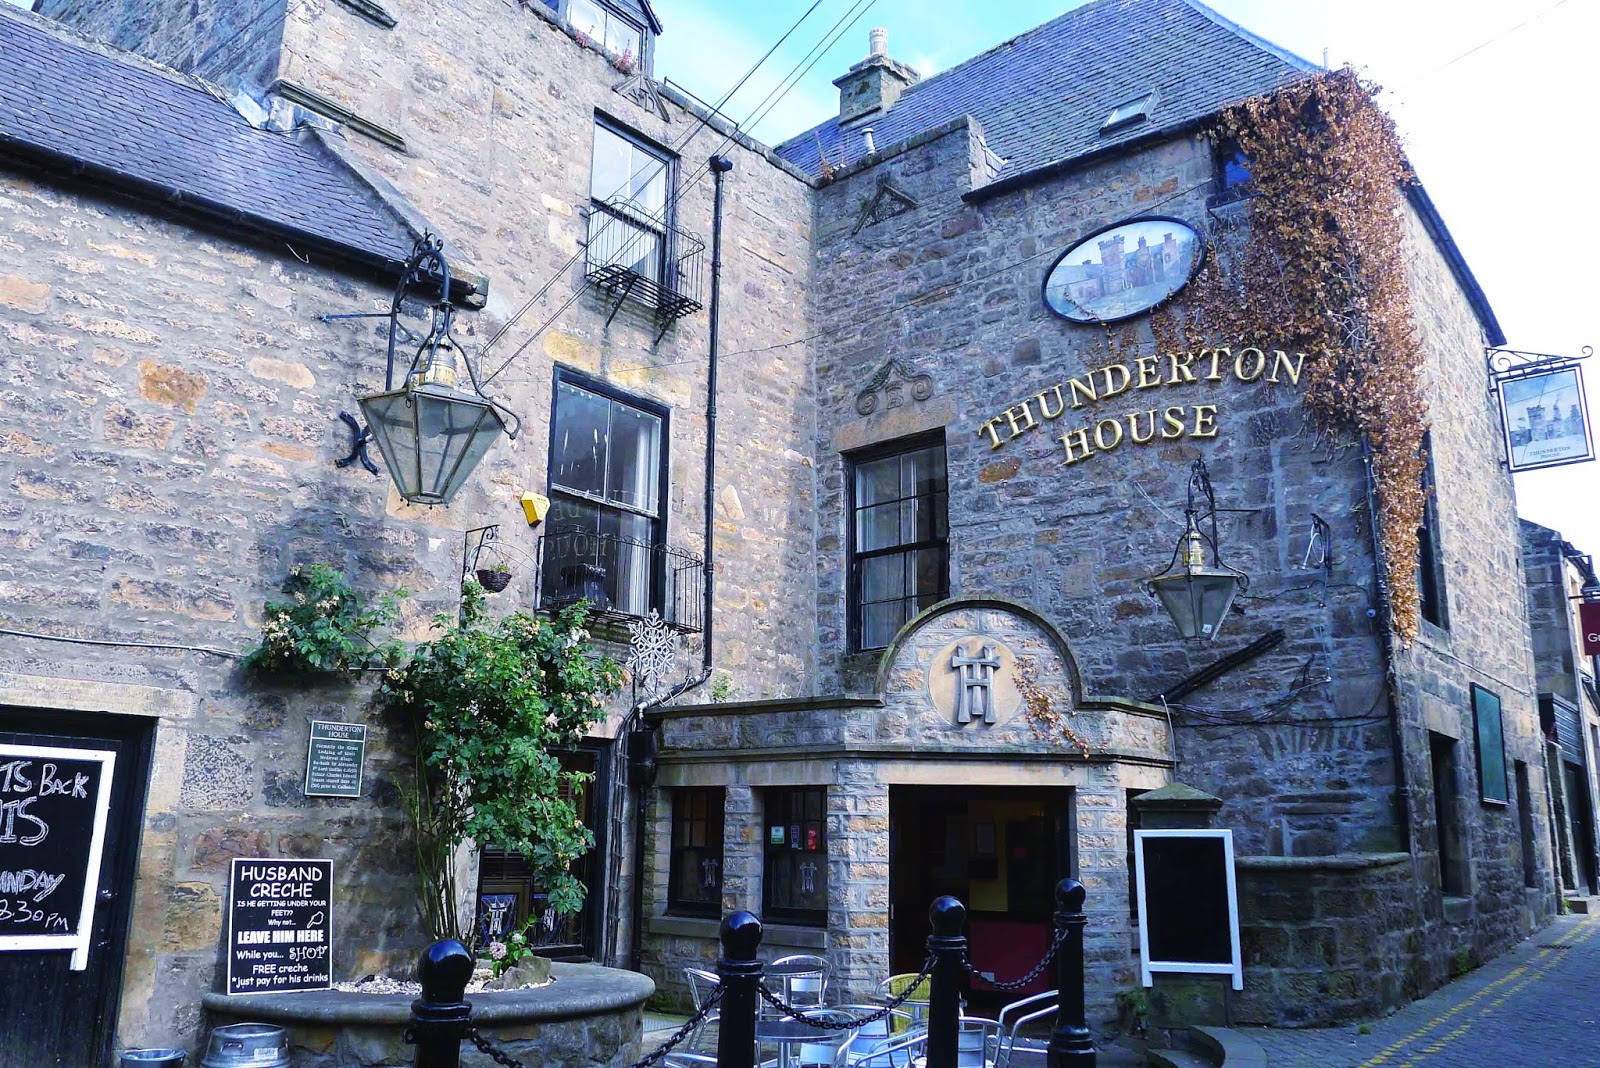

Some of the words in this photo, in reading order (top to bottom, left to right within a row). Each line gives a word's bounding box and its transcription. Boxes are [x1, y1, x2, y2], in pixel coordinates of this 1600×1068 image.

[977, 347, 1306, 451] THUNDERTON
[1059, 403, 1219, 466] HOUSE
[317, 723, 362, 733] THUNDERTON
[328, 731, 350, 739] HOUSE
[0, 795, 49, 847] IS
[241, 865, 323, 881] HUSBAND
[250, 882, 313, 898] CRECHE
[271, 909, 293, 917] FEET??
[267, 919, 281, 927] Why
[237, 930, 271, 945] LEAVE
[272, 930, 295, 943] HIM
[296, 929, 324, 943] HERE
[236, 950, 261, 960] While
[289, 945, 327, 962] SHOP
[252, 964, 277, 975] FREE
[278, 963, 308, 973] creche
[256, 977, 271, 987] pay
[273, 975, 287, 984] for
[288, 974, 301, 983] his
[303, 973, 328, 982] drinks
